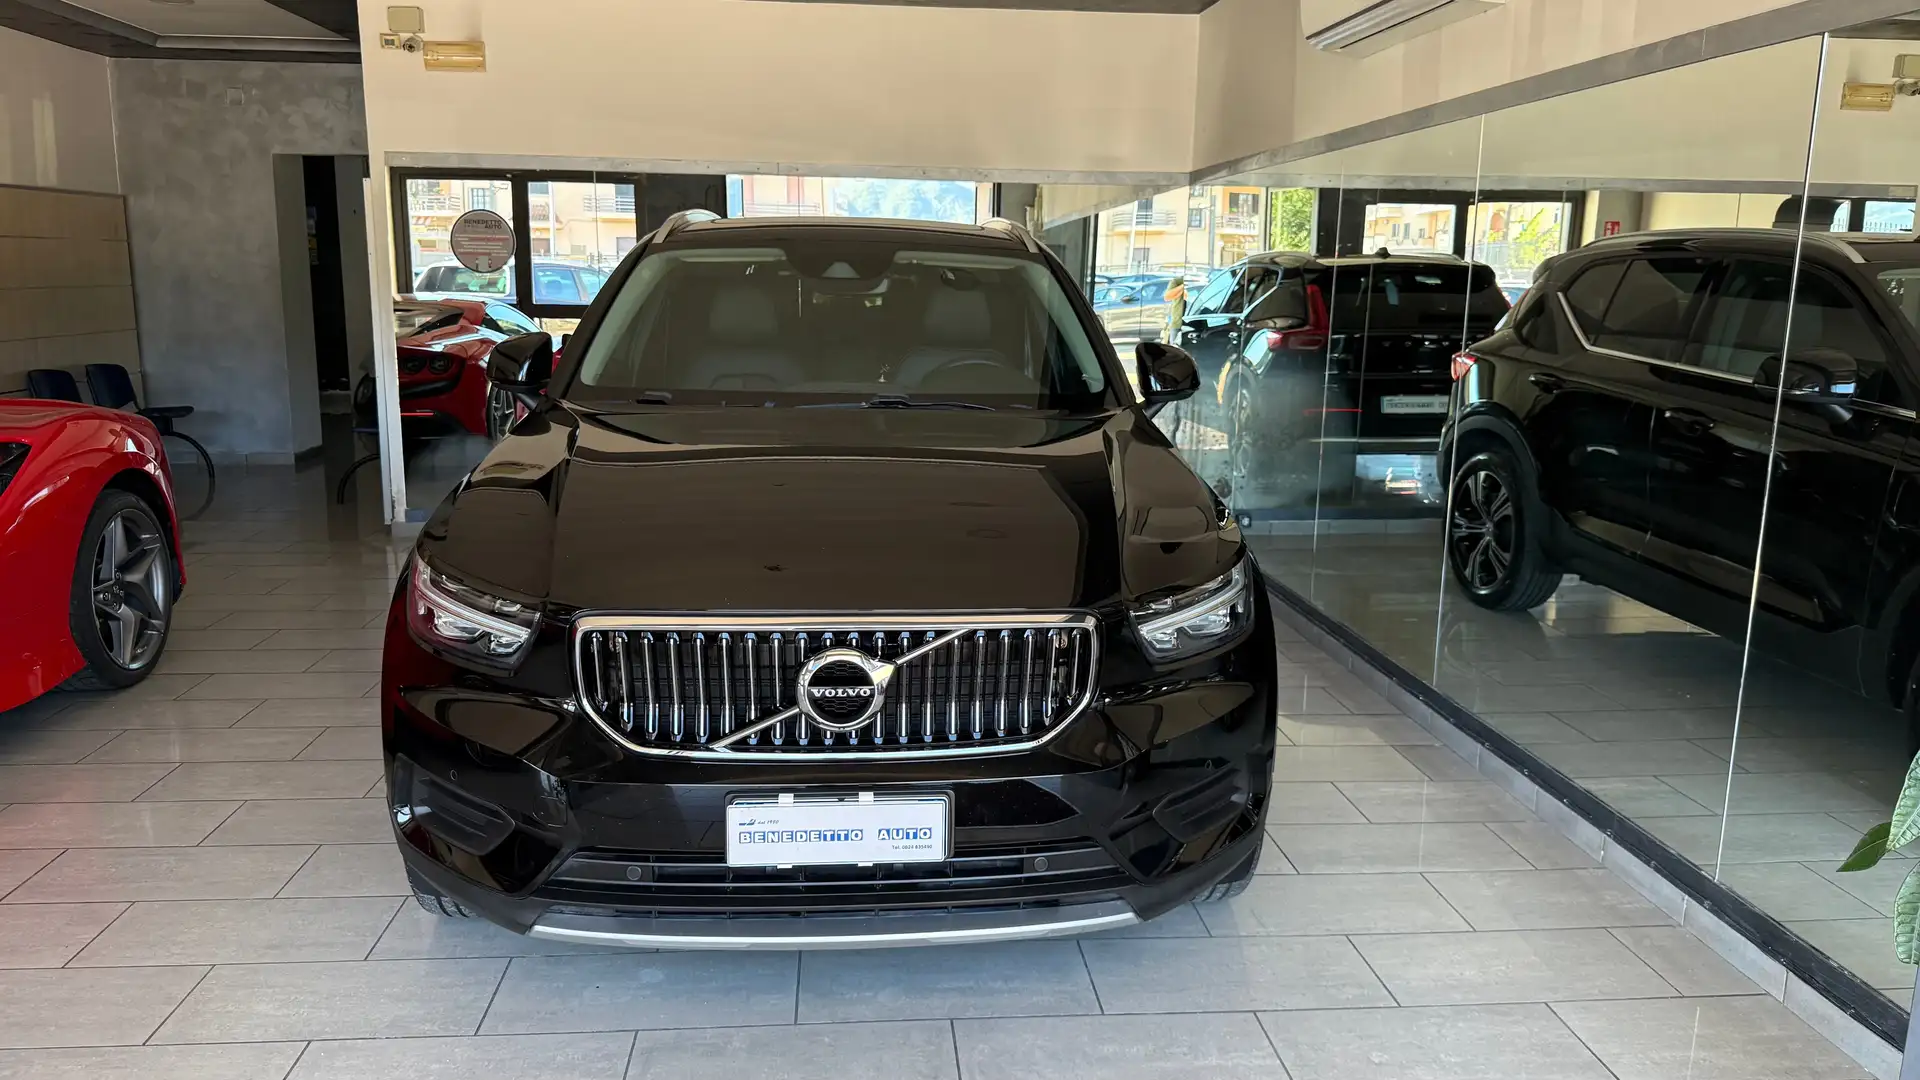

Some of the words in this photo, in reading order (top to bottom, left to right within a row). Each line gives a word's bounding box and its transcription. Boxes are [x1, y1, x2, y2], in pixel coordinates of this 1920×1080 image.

[810, 688, 871, 697] VOLVO
[739, 828, 863, 844] BENEDETTO
[877, 827, 933, 841] AUTO
